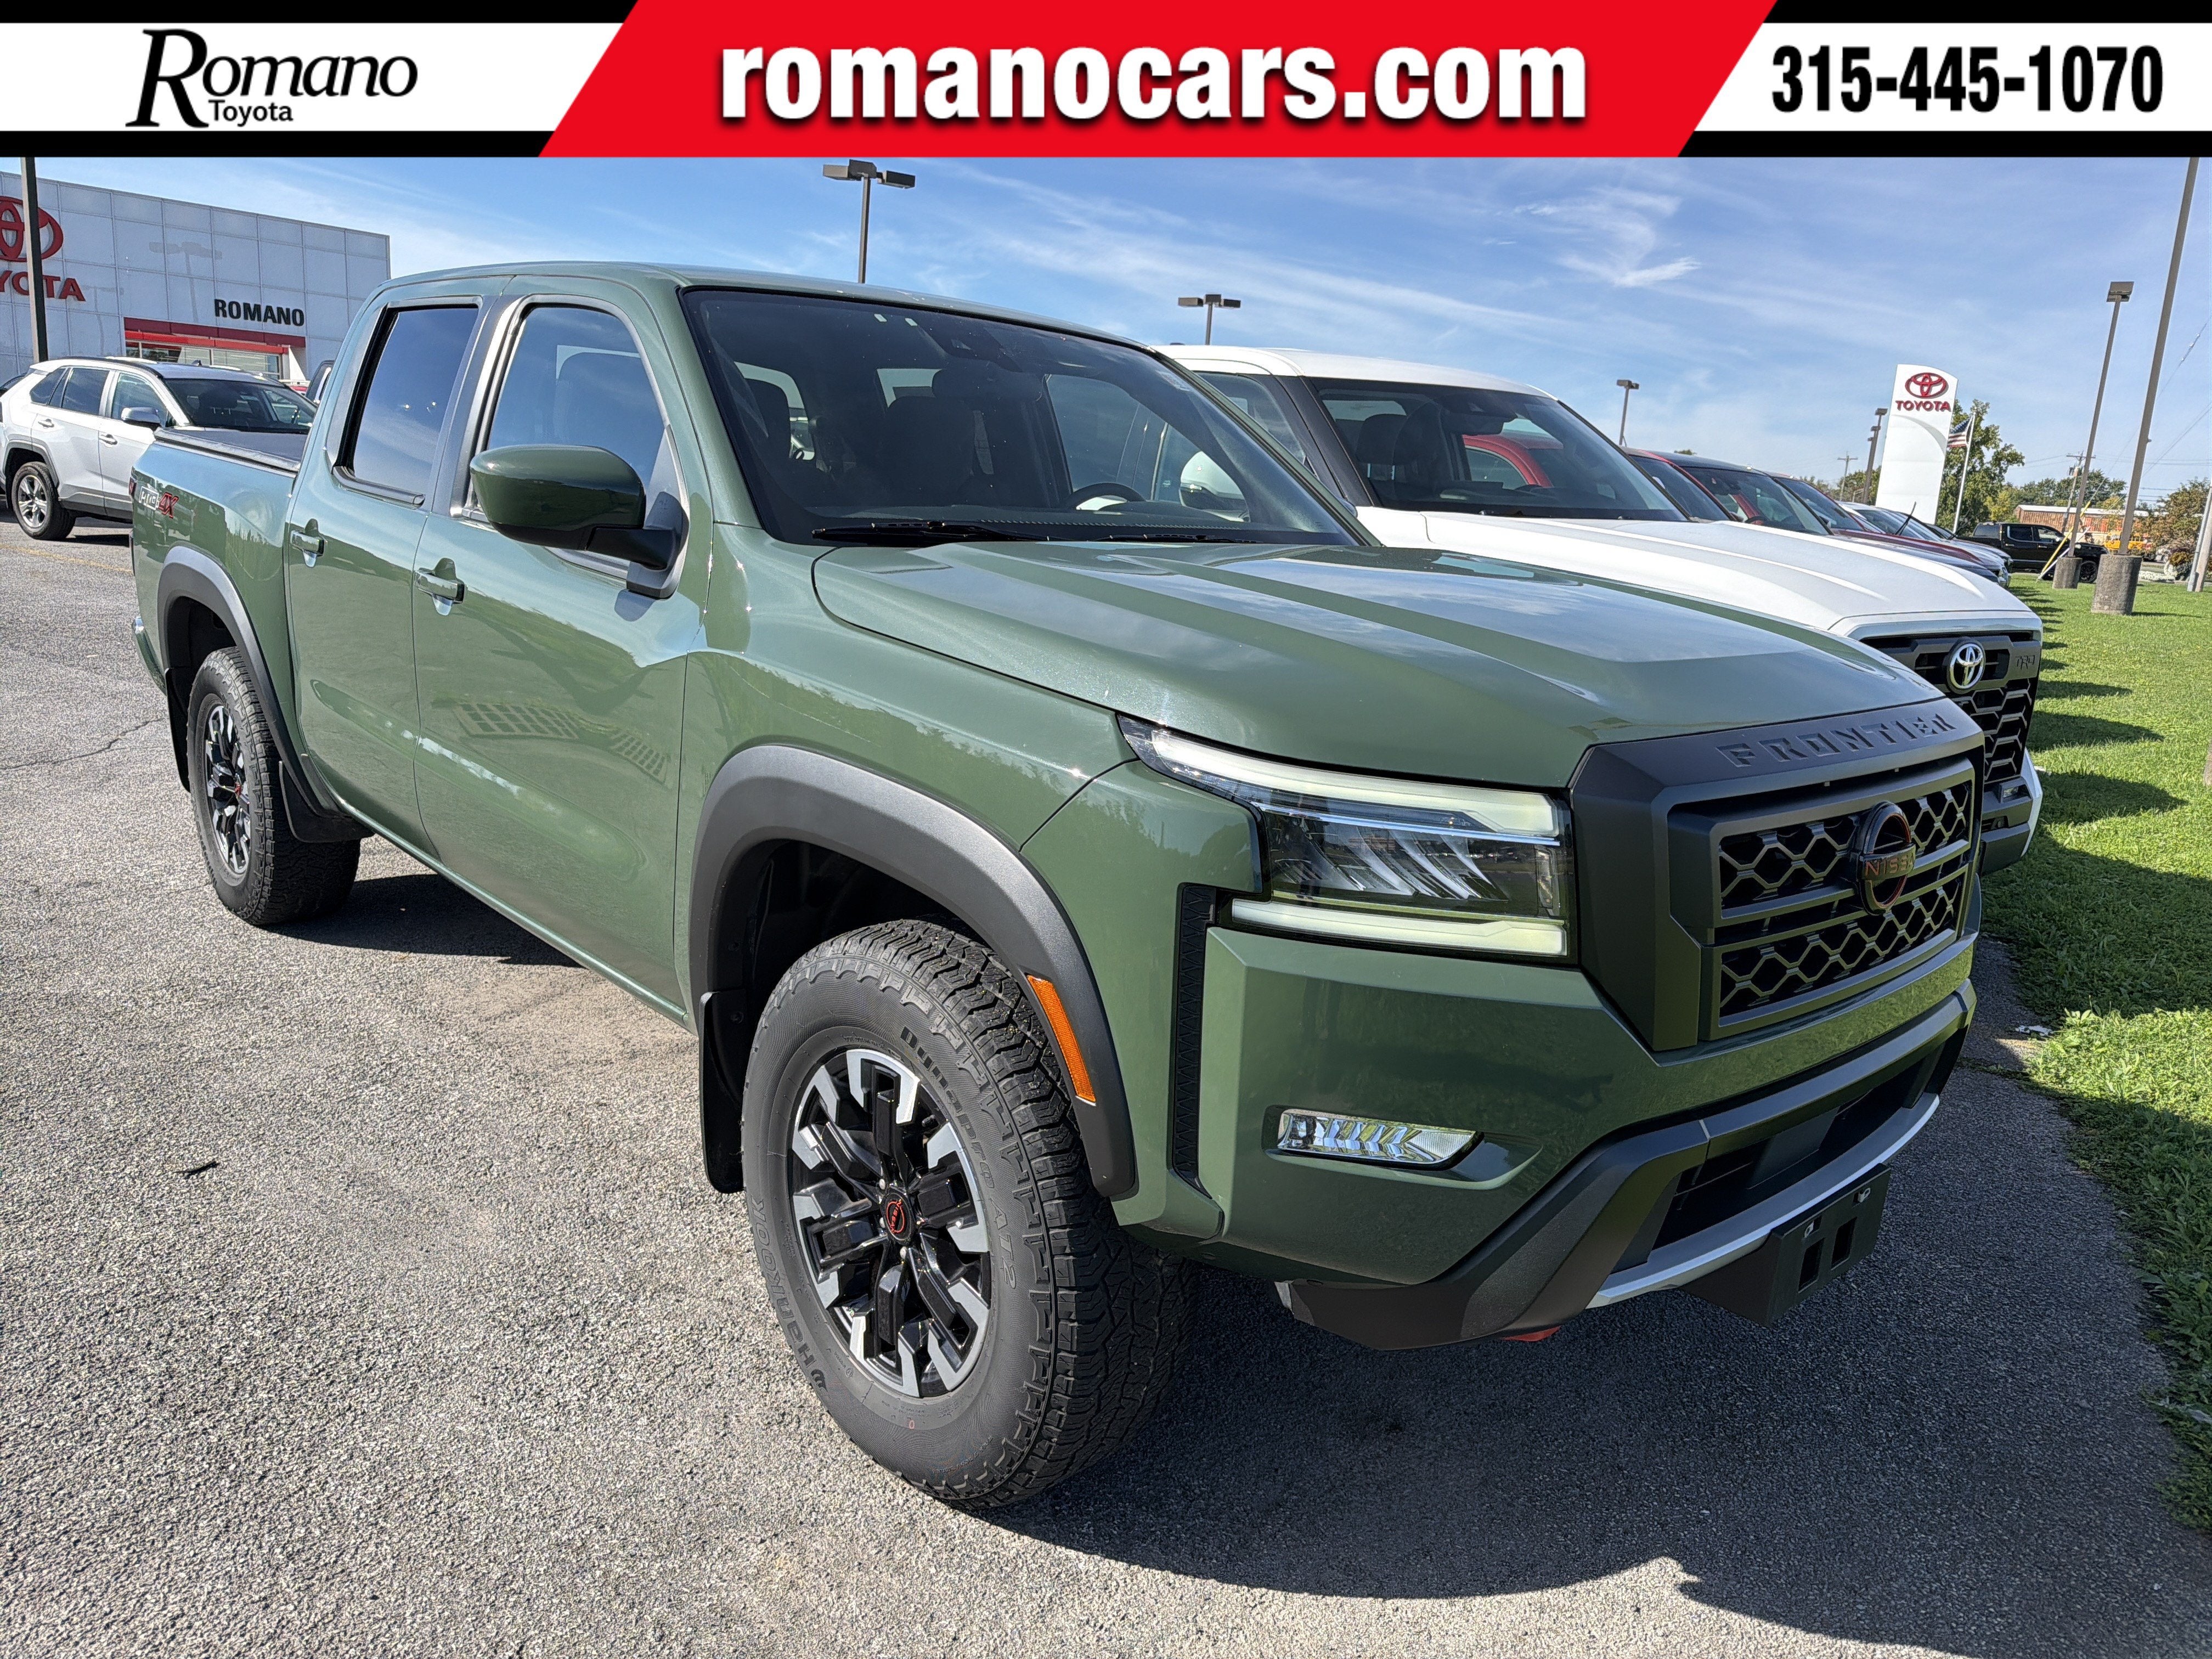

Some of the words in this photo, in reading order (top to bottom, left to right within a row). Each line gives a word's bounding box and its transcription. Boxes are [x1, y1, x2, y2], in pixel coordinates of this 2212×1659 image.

[0, 270, 86, 302] YOTA
[214, 298, 305, 327] ROMANO
[1895, 399, 1952, 413] TOYOTA
[1715, 713, 1957, 768] FRONTIER
[1865, 851, 1914, 877] NISSA
